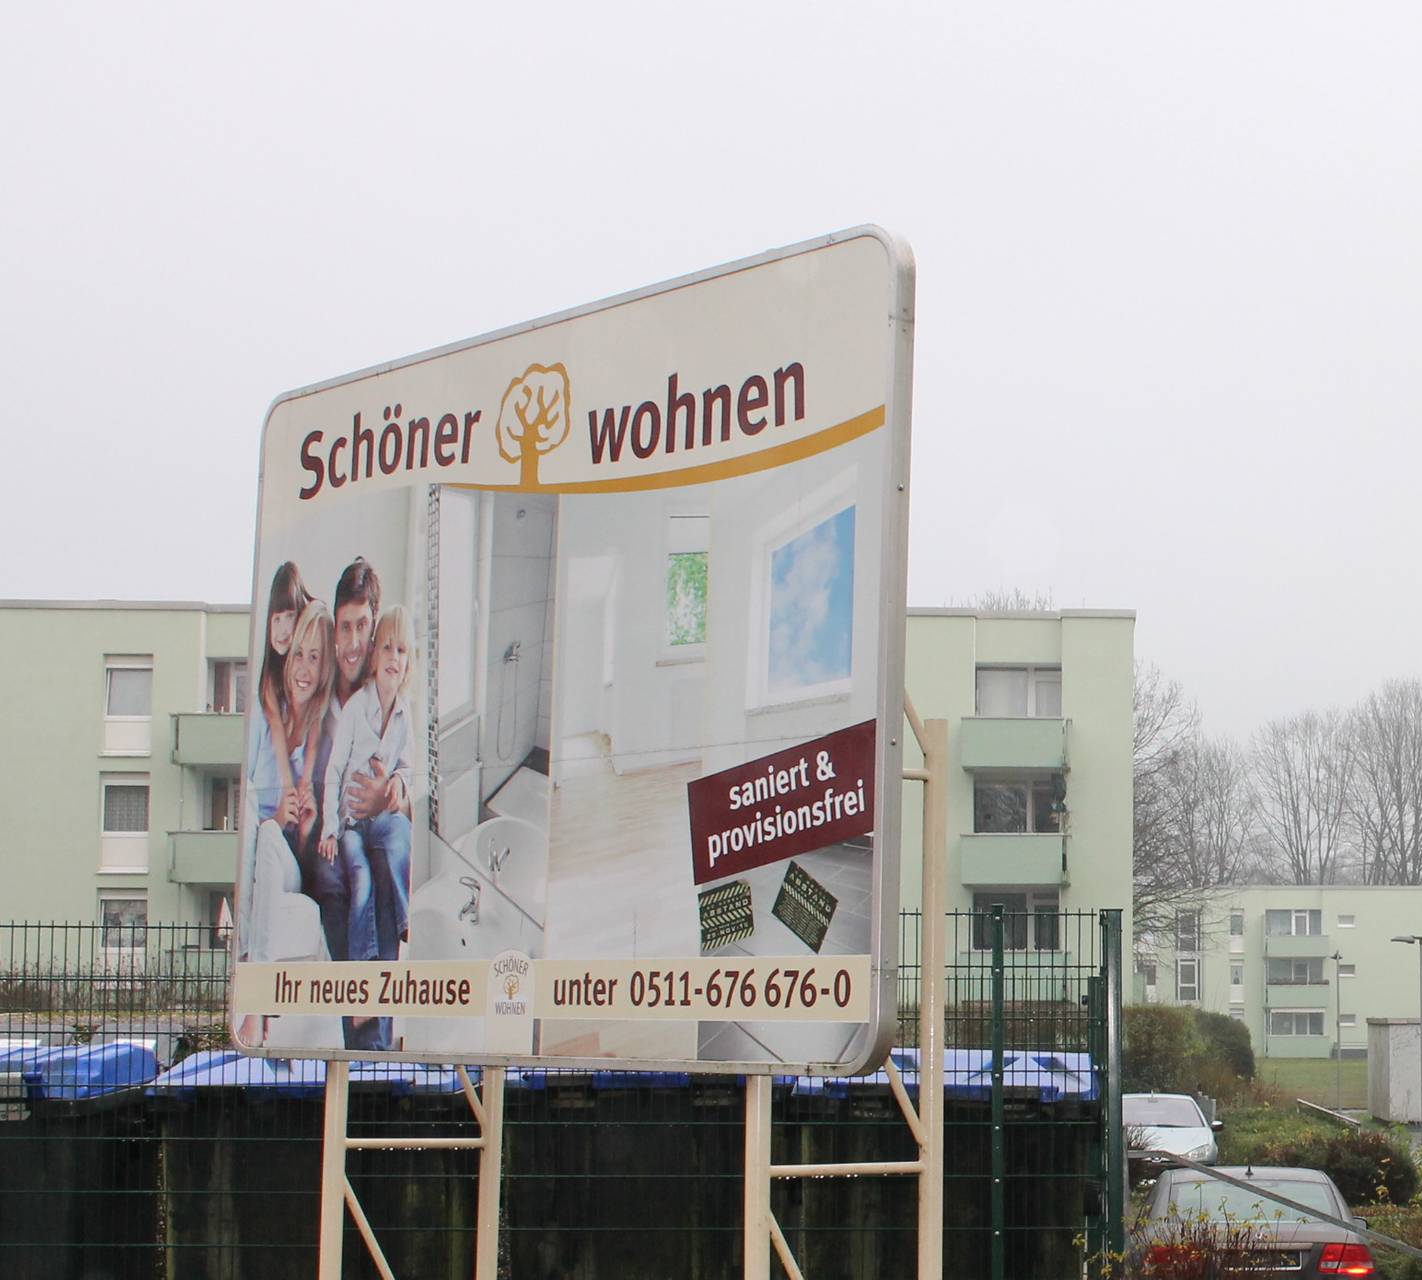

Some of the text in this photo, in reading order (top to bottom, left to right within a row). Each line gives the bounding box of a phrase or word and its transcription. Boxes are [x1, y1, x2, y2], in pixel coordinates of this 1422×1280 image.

[299, 362, 805, 500] Schöner wohnen
[729, 750, 836, 810] saniert &
[707, 778, 865, 868] provisionsfrei
[275, 970, 471, 1005] Ihr neues Zuhause
[495, 1002, 526, 1016] WOHNEN
[553, 968, 851, 1009] unter 0511-676 676-0
